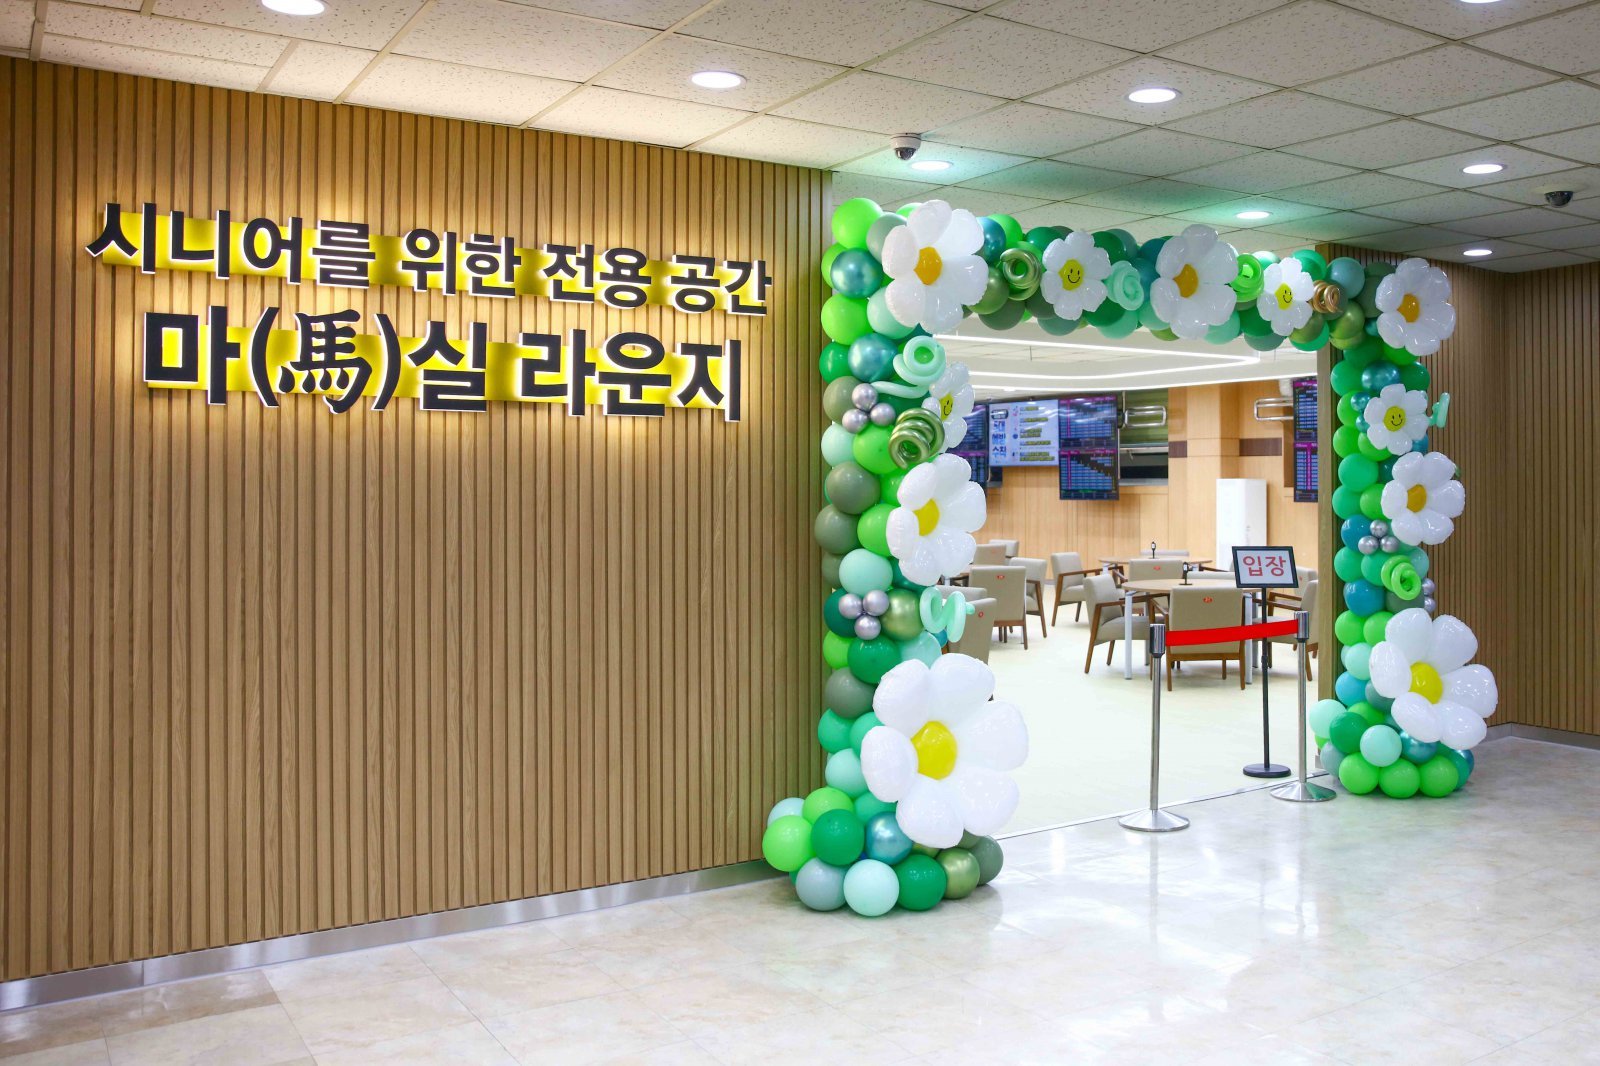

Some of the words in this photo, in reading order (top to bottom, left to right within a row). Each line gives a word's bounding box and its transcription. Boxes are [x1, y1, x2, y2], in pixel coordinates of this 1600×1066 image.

[85, 202, 376, 288] 시니어를
[400, 228, 522, 298] 위한
[542, 243, 652, 309] 전용
[667, 253, 773, 316] 공간
[143, 304, 488, 414] 마(馬)실
[518, 328, 742, 422] 라운지
[1242, 555, 1287, 577] 입장
